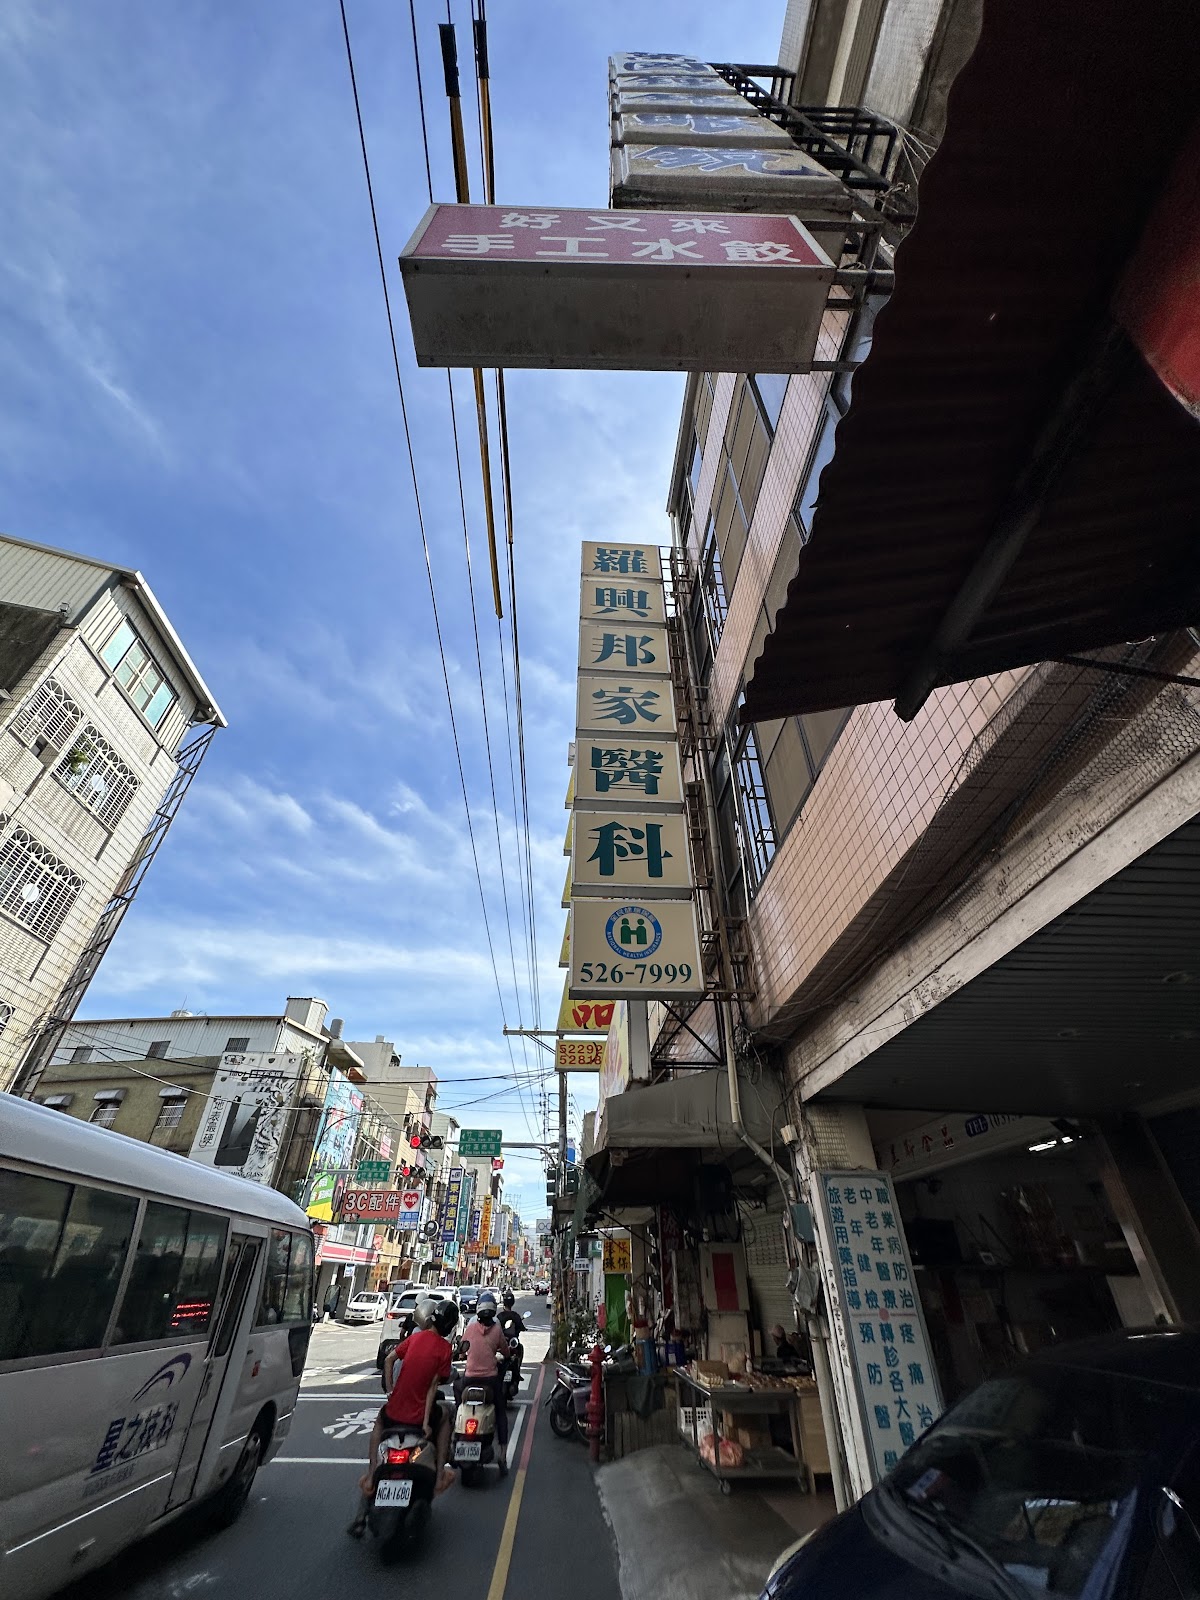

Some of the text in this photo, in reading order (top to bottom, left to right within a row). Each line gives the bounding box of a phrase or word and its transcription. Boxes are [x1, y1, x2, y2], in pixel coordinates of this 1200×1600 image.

[441, 233, 801, 263] 手工水餃
[499, 212, 731, 234] 好又來
[586, 547, 674, 878] 羅興邦家醫科
[580, 962, 693, 985] 526-7999
[344, 1192, 400, 1211] 3C配件
[843, 1187, 880, 1309] 老年健檢
[859, 1187, 898, 1309] 中老年醫療
[875, 1187, 915, 1309] 職業病防治
